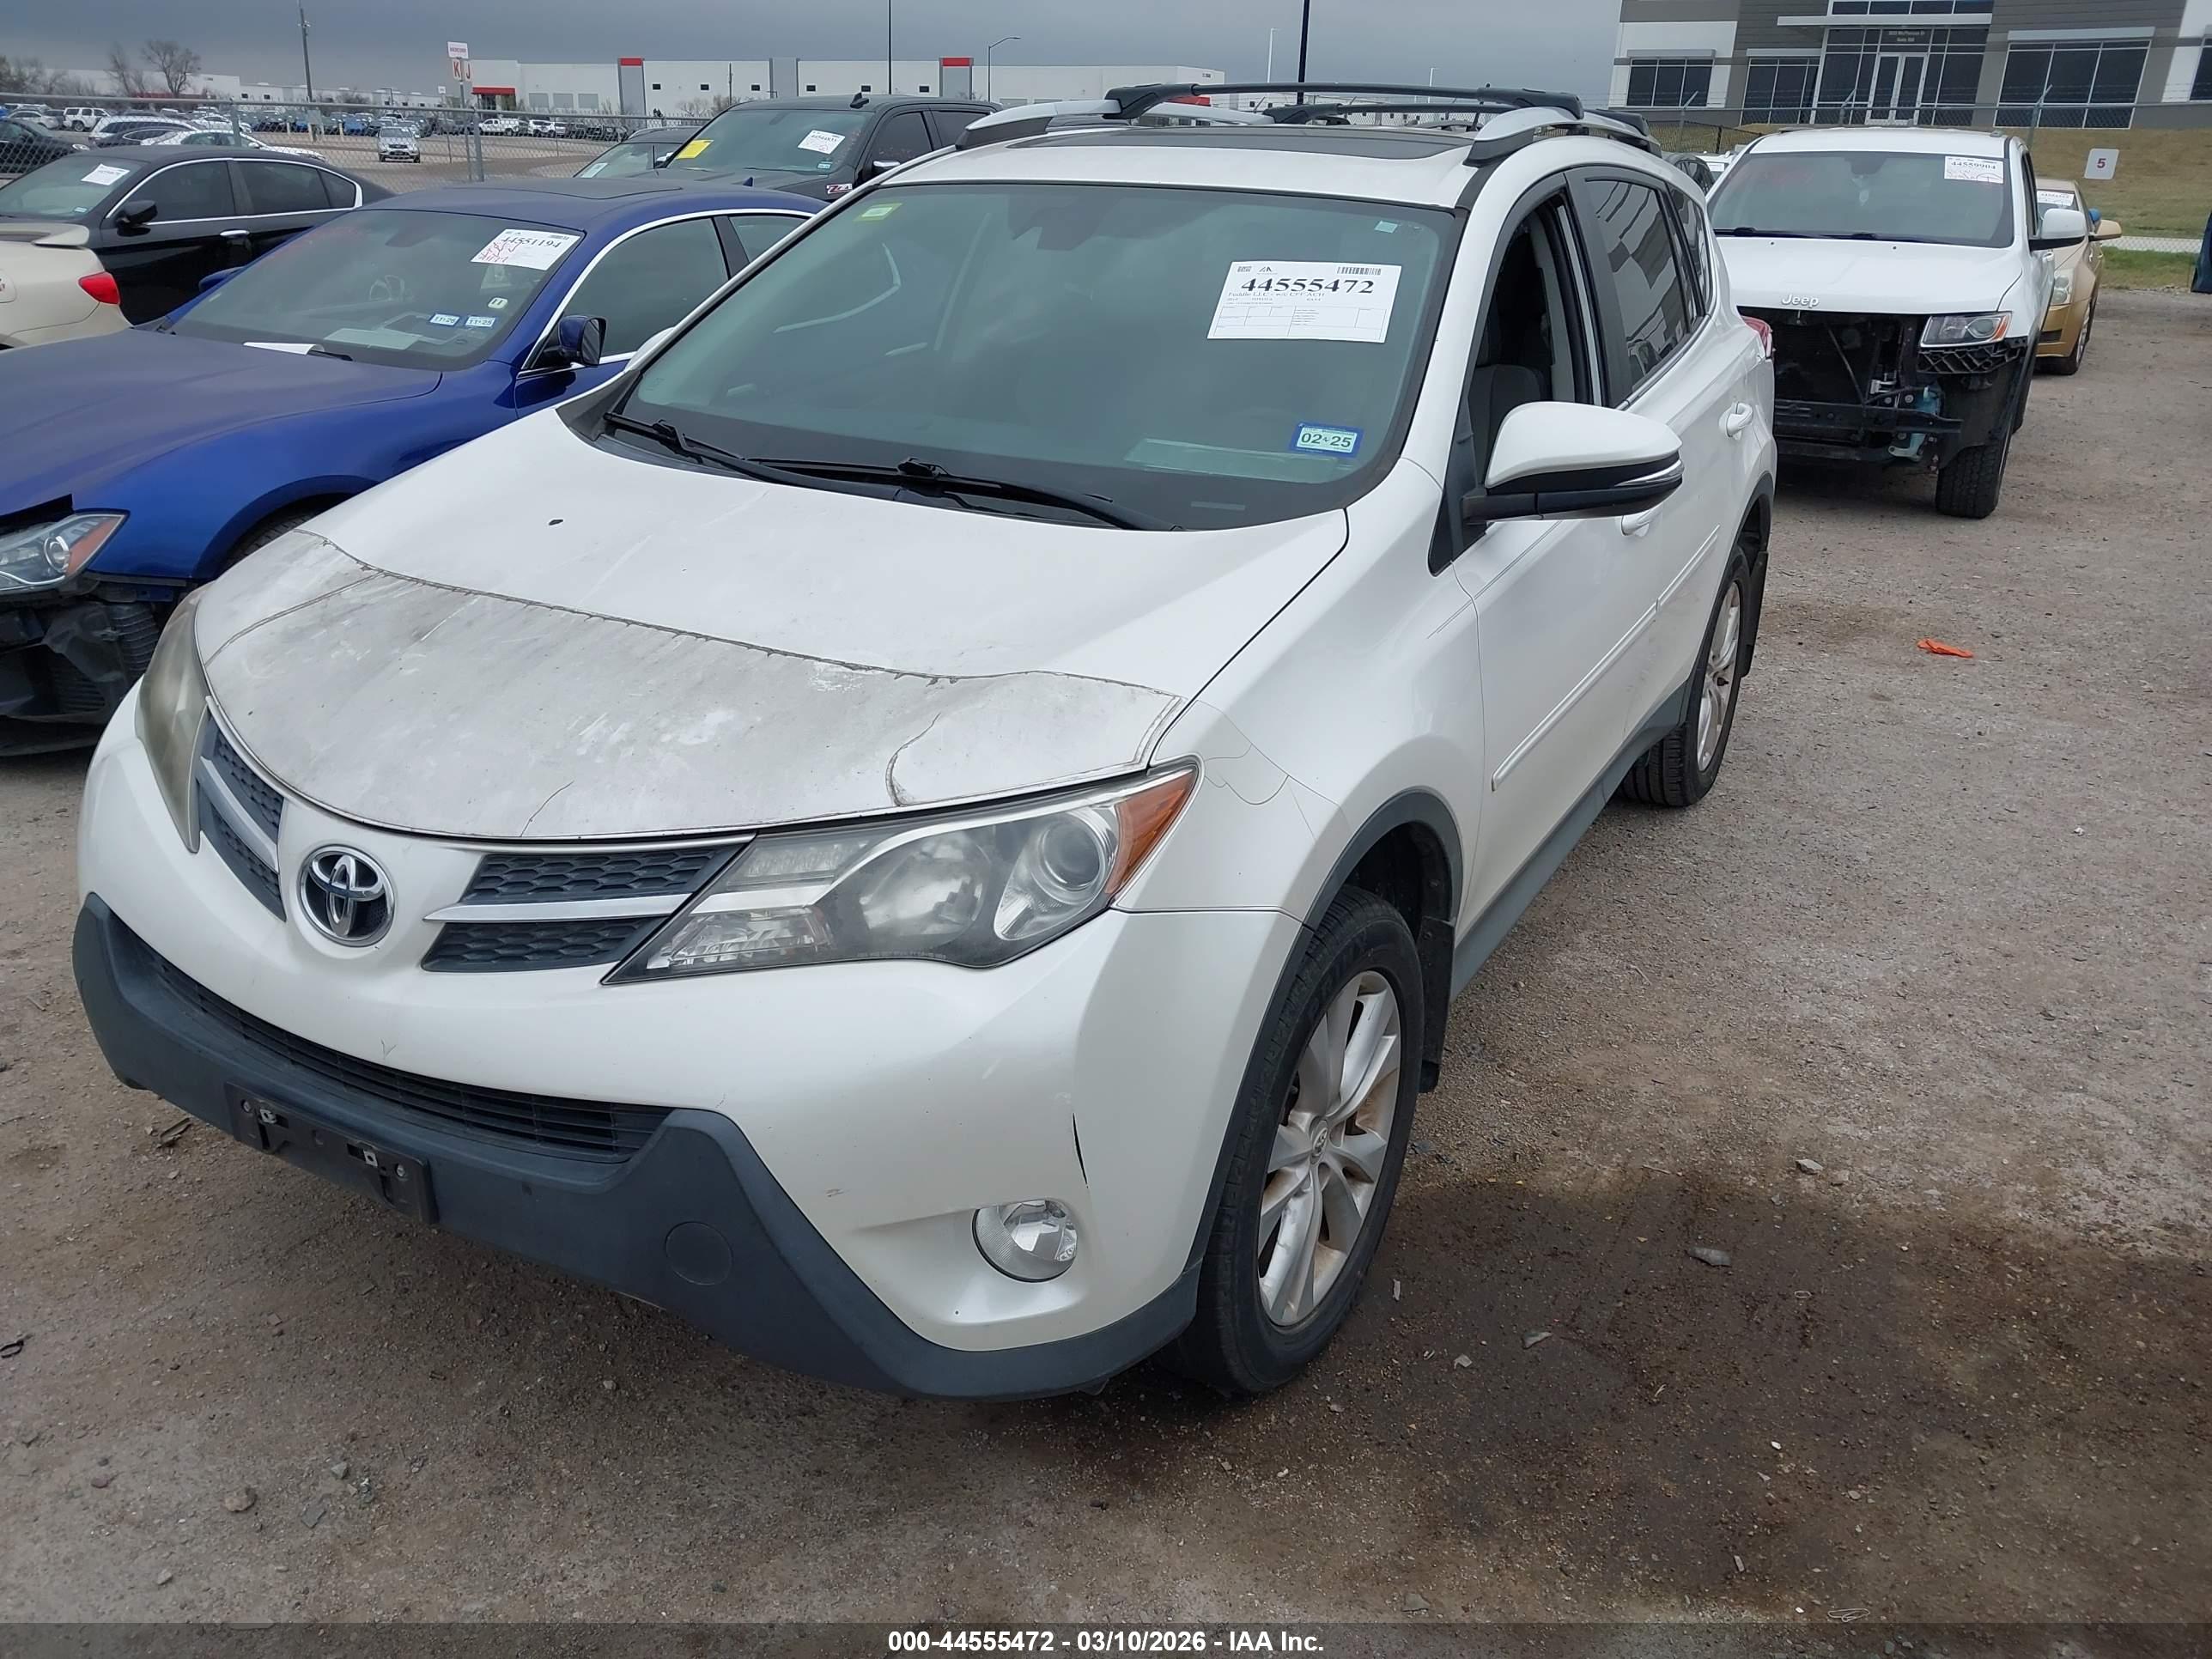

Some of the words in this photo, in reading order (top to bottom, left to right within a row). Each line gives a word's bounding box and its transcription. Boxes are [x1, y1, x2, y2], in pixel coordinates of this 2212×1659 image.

[453, 61, 461, 77] K
[465, 63, 471, 79] J
[2097, 158, 2106, 168] 5
[1242, 278, 1375, 294] 44555472
[1782, 294, 1820, 308] Jeep
